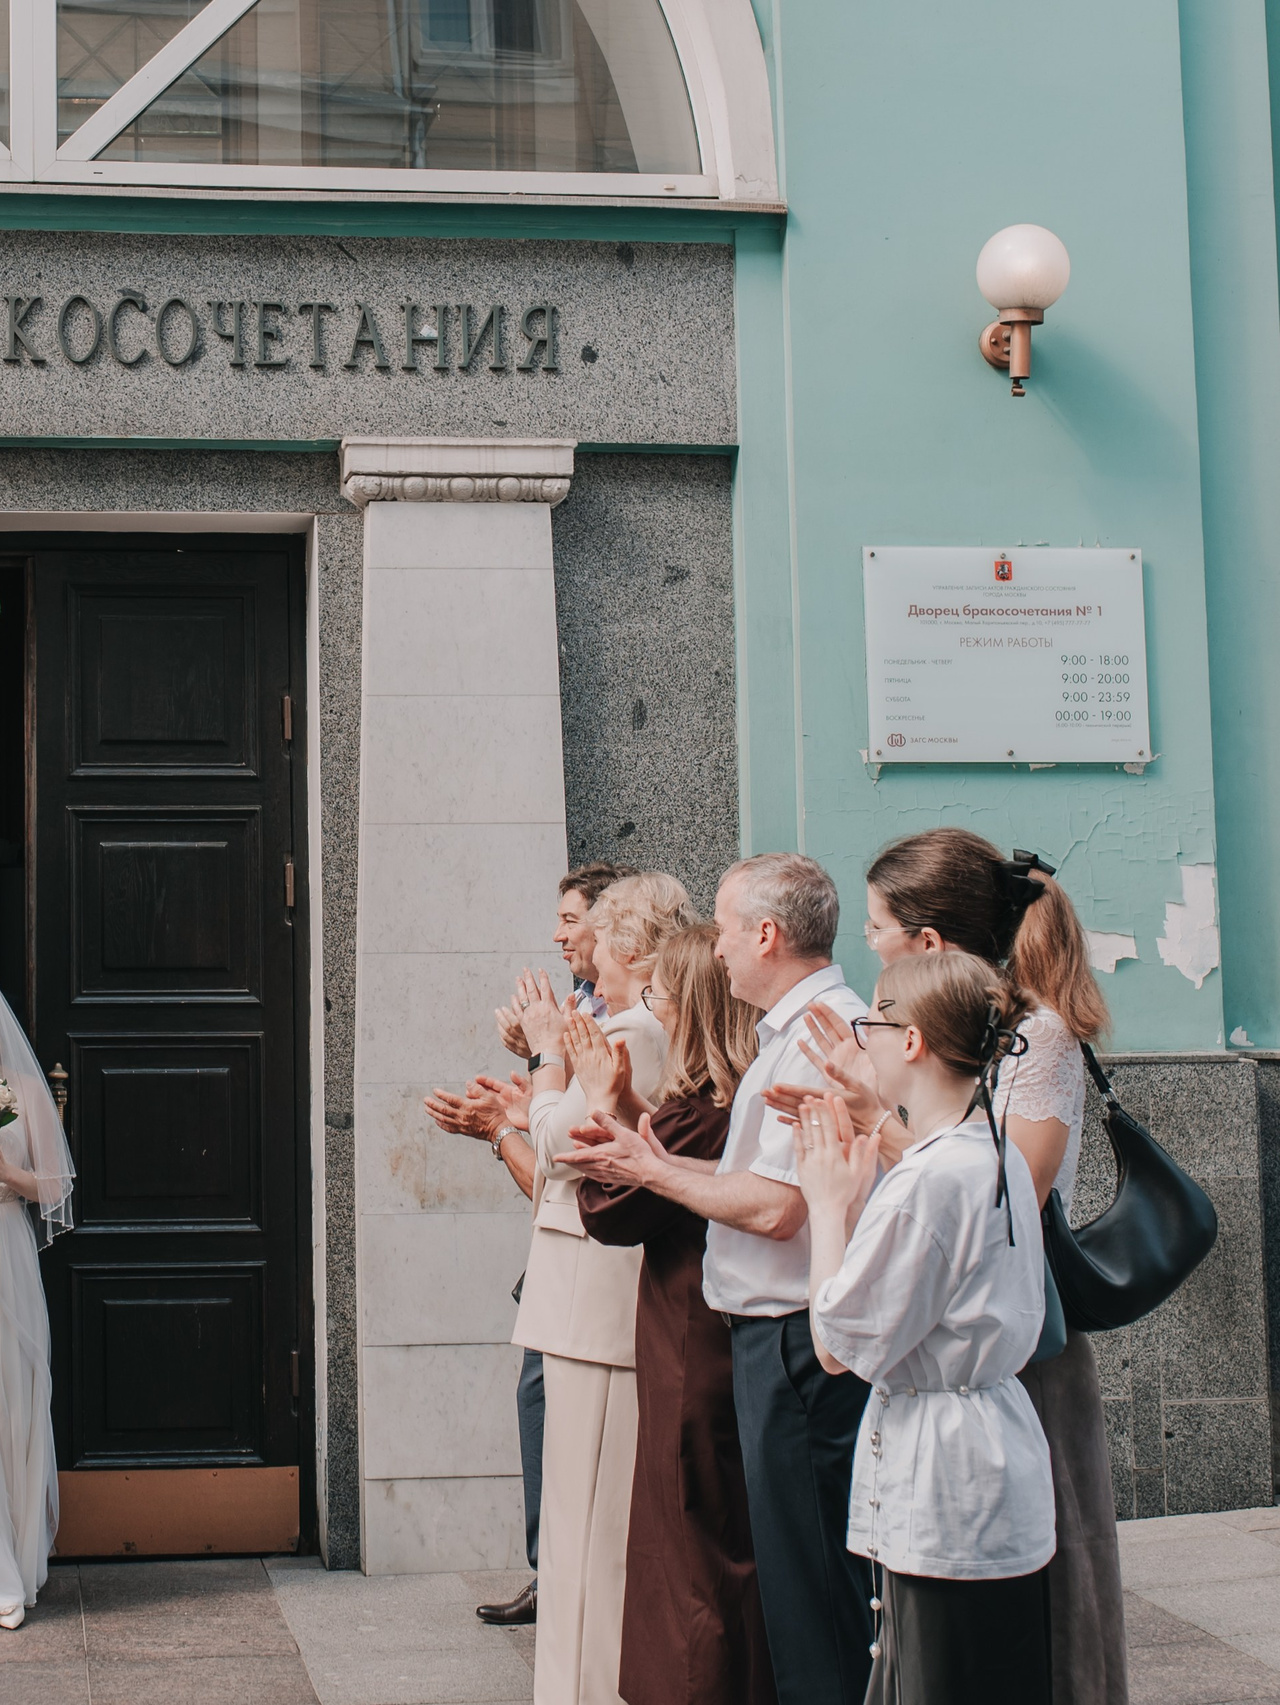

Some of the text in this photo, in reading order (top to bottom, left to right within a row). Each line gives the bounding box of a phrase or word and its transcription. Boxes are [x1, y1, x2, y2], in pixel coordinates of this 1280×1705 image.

[907, 604, 1103, 620] Дворец бракосочетания № 1
[959, 637, 1053, 648] РЕЖИМ РАБОТЫ
[1060, 655, 1087, 666] 9:00
[1098, 655, 1129, 666] 18:00
[1061, 673, 1088, 684] 9:00
[1097, 673, 1130, 684] 20:00
[1062, 692, 1088, 703] 9:00
[1097, 692, 1131, 703] 23:59
[1055, 710, 1089, 722] 00:00
[1100, 710, 1132, 722] 19:00
